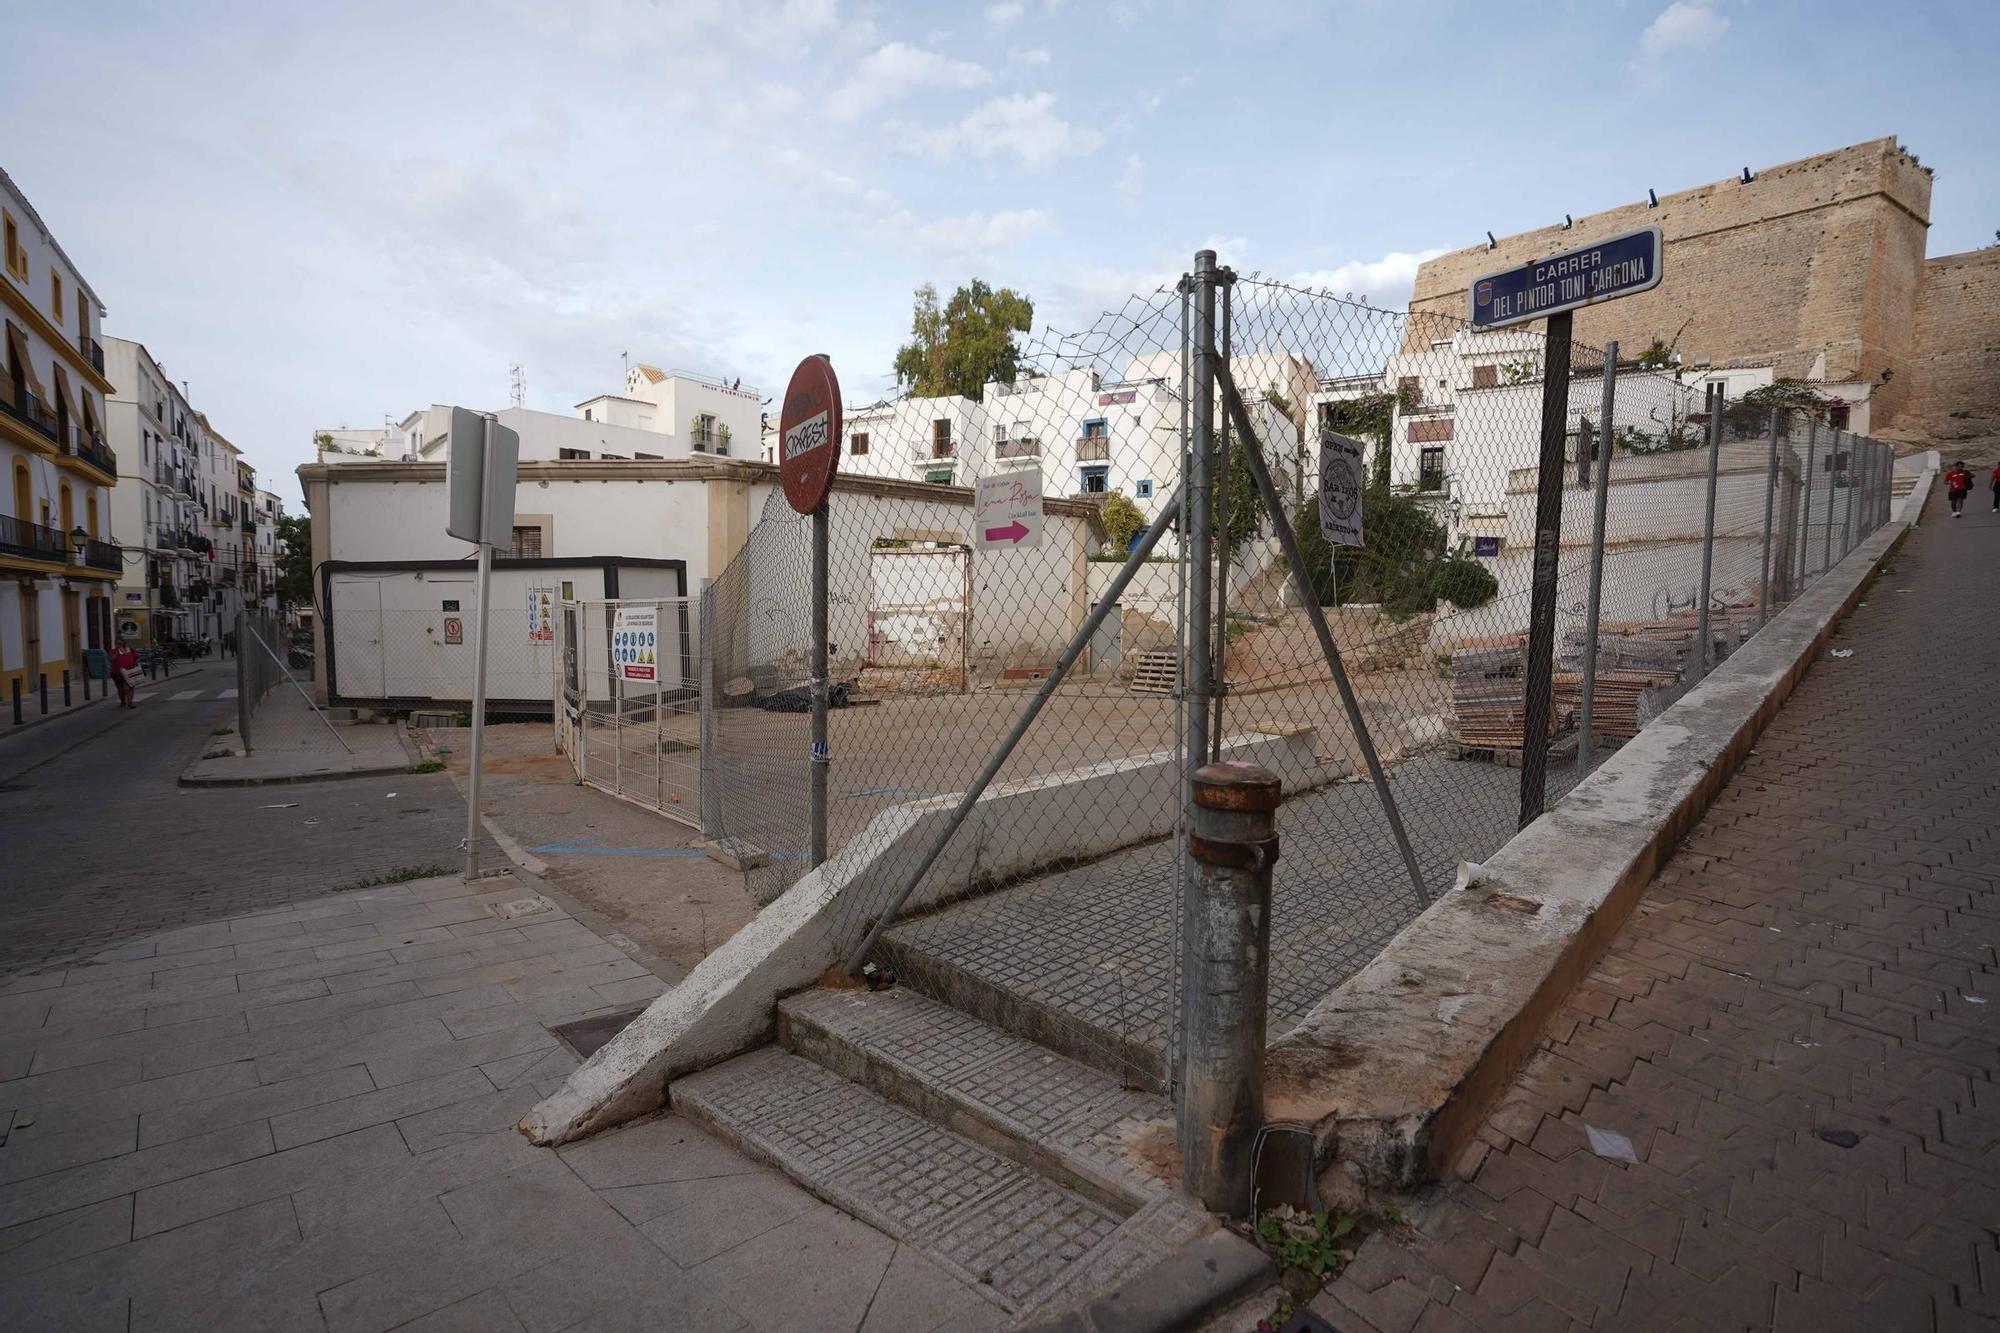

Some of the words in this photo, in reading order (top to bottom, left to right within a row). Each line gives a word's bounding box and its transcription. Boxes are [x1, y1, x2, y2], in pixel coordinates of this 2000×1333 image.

[1536, 251, 1601, 282] CARRER
[1493, 297, 1512, 319] DEL
[1517, 285, 1555, 313] PINTOR
[1560, 274, 1586, 301] TONI
